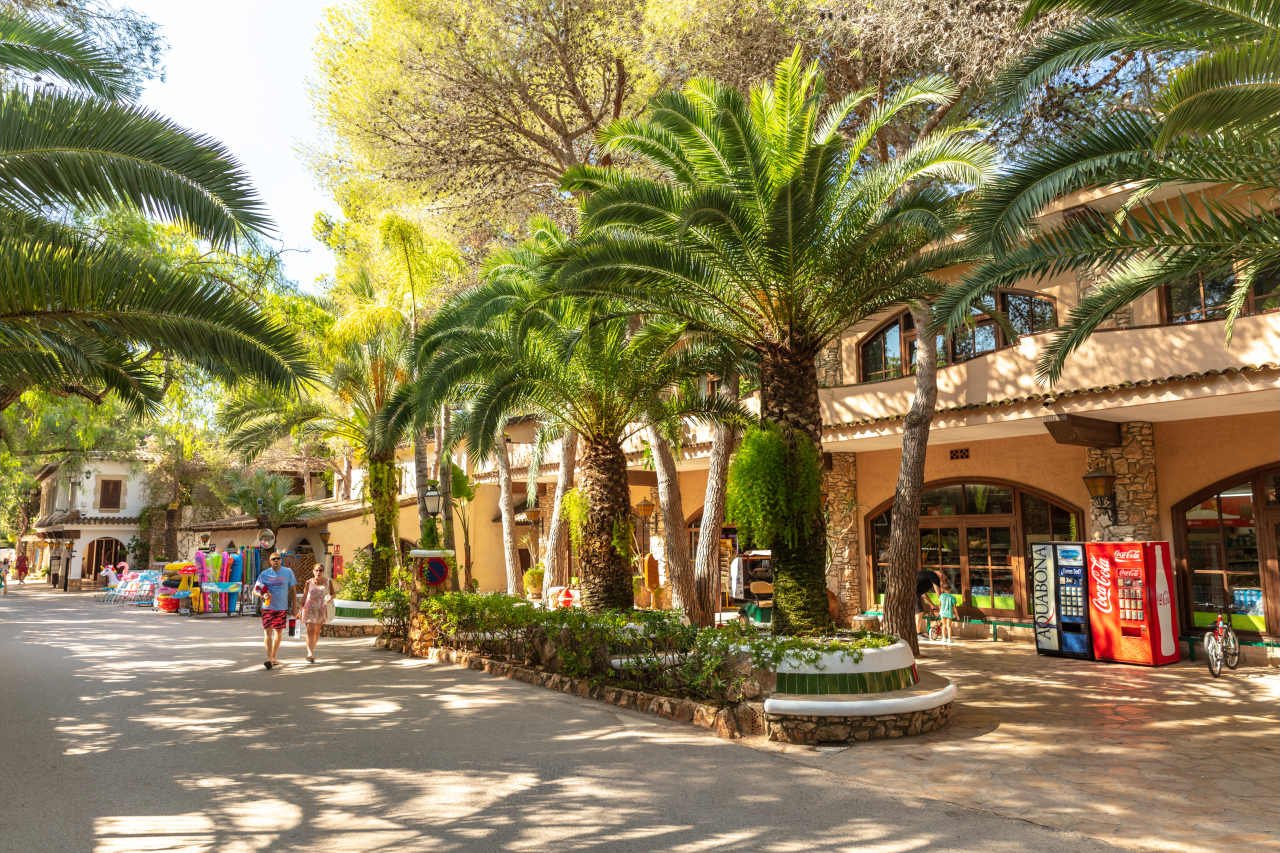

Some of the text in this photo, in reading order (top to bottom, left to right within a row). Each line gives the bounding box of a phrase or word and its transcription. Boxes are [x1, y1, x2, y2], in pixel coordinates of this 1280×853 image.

[1090, 552, 1112, 614] Coca-Cola
[1114, 549, 1142, 562] Coca-Cola
[1034, 546, 1053, 640] AQUABONA
